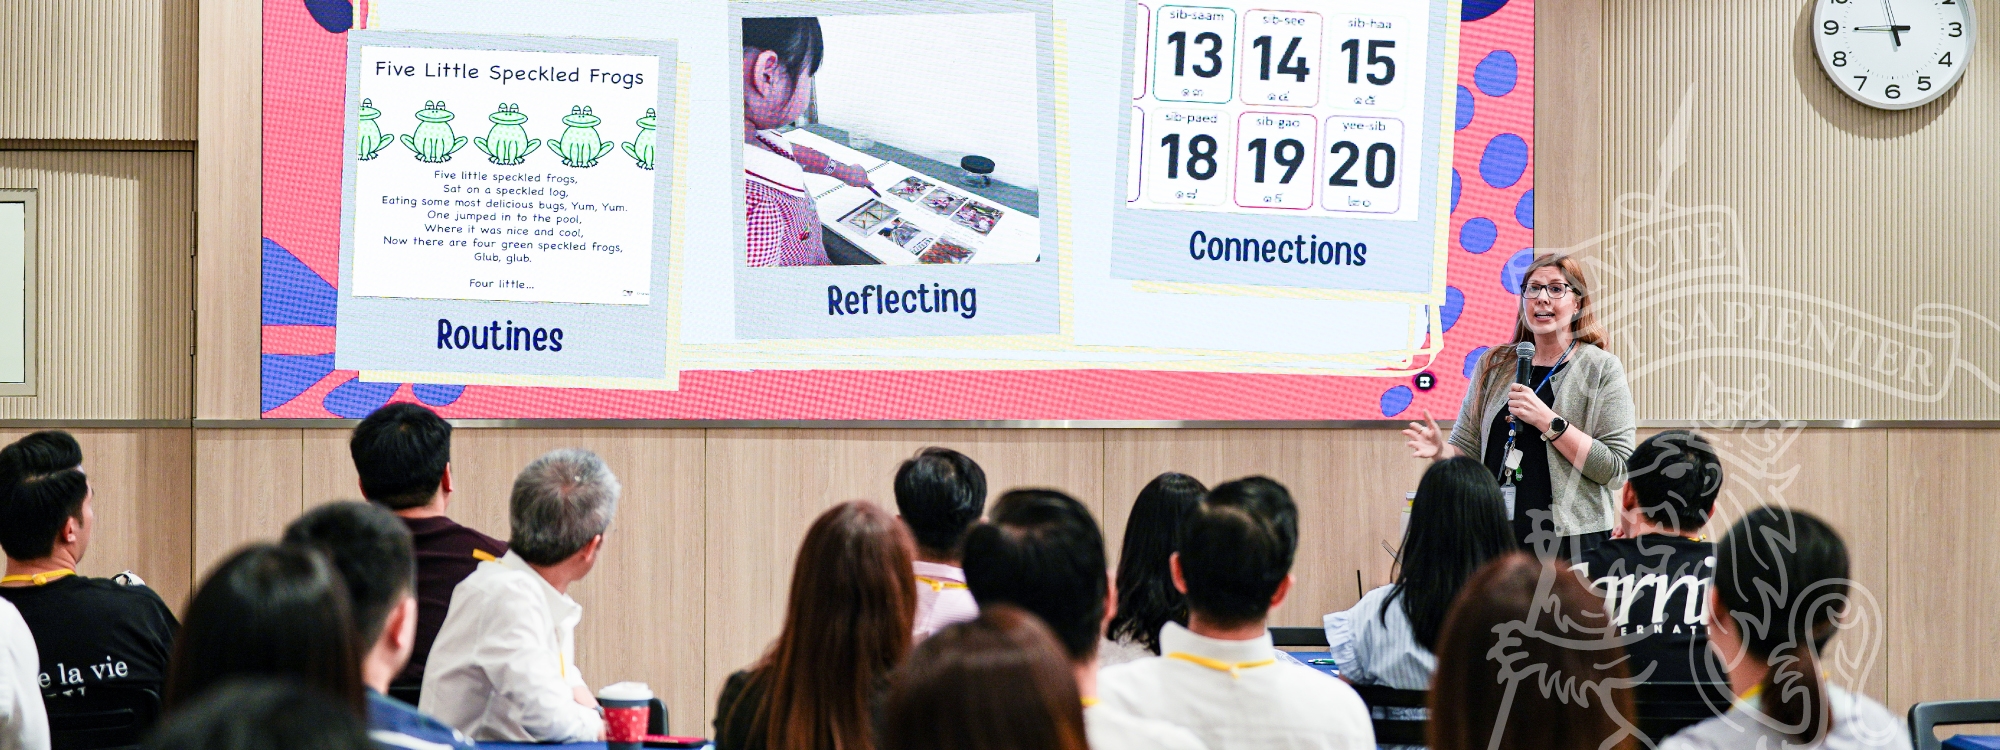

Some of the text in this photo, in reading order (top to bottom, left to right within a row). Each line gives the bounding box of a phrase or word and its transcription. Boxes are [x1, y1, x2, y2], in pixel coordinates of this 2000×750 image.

[1823, 20, 1840, 35] 9
[1948, 22, 1963, 37] 3
[1167, 31, 1222, 78] 13
[1253, 35, 1310, 82] 14
[1341, 39, 1396, 86] 15
[1832, 51, 1847, 67] 8
[1937, 52, 1953, 67] 4
[376, 61, 643, 89] Five Little Speckled Frogs
[1853, 76, 1868, 91] 7
[1917, 77, 1932, 91] 5
[1884, 85, 1901, 99] 6
[1161, 133, 1218, 180] 18
[1248, 138, 1305, 184] 19
[1329, 141, 1396, 188] 20
[435, 170, 577, 186] Five little speckled frogs,
[444, 184, 568, 198] Sat on a speckled log,
[382, 196, 627, 212] Eating some most delicious bugs, Yum, Yum.
[428, 210, 581, 225] One jumped in to the pool,
[424, 224, 583, 238] Where it was nice and cool,
[384, 235, 622, 254] Now there are four green speckled frogs,
[1190, 231, 1366, 266] Connections
[474, 252, 531, 264] Glub, glub.
[469, 278, 494, 287] Four
[828, 283, 976, 319] Reflecting
[438, 319, 563, 352] Routines
[57, 662, 84, 685] la
[90, 655, 128, 680] vie
